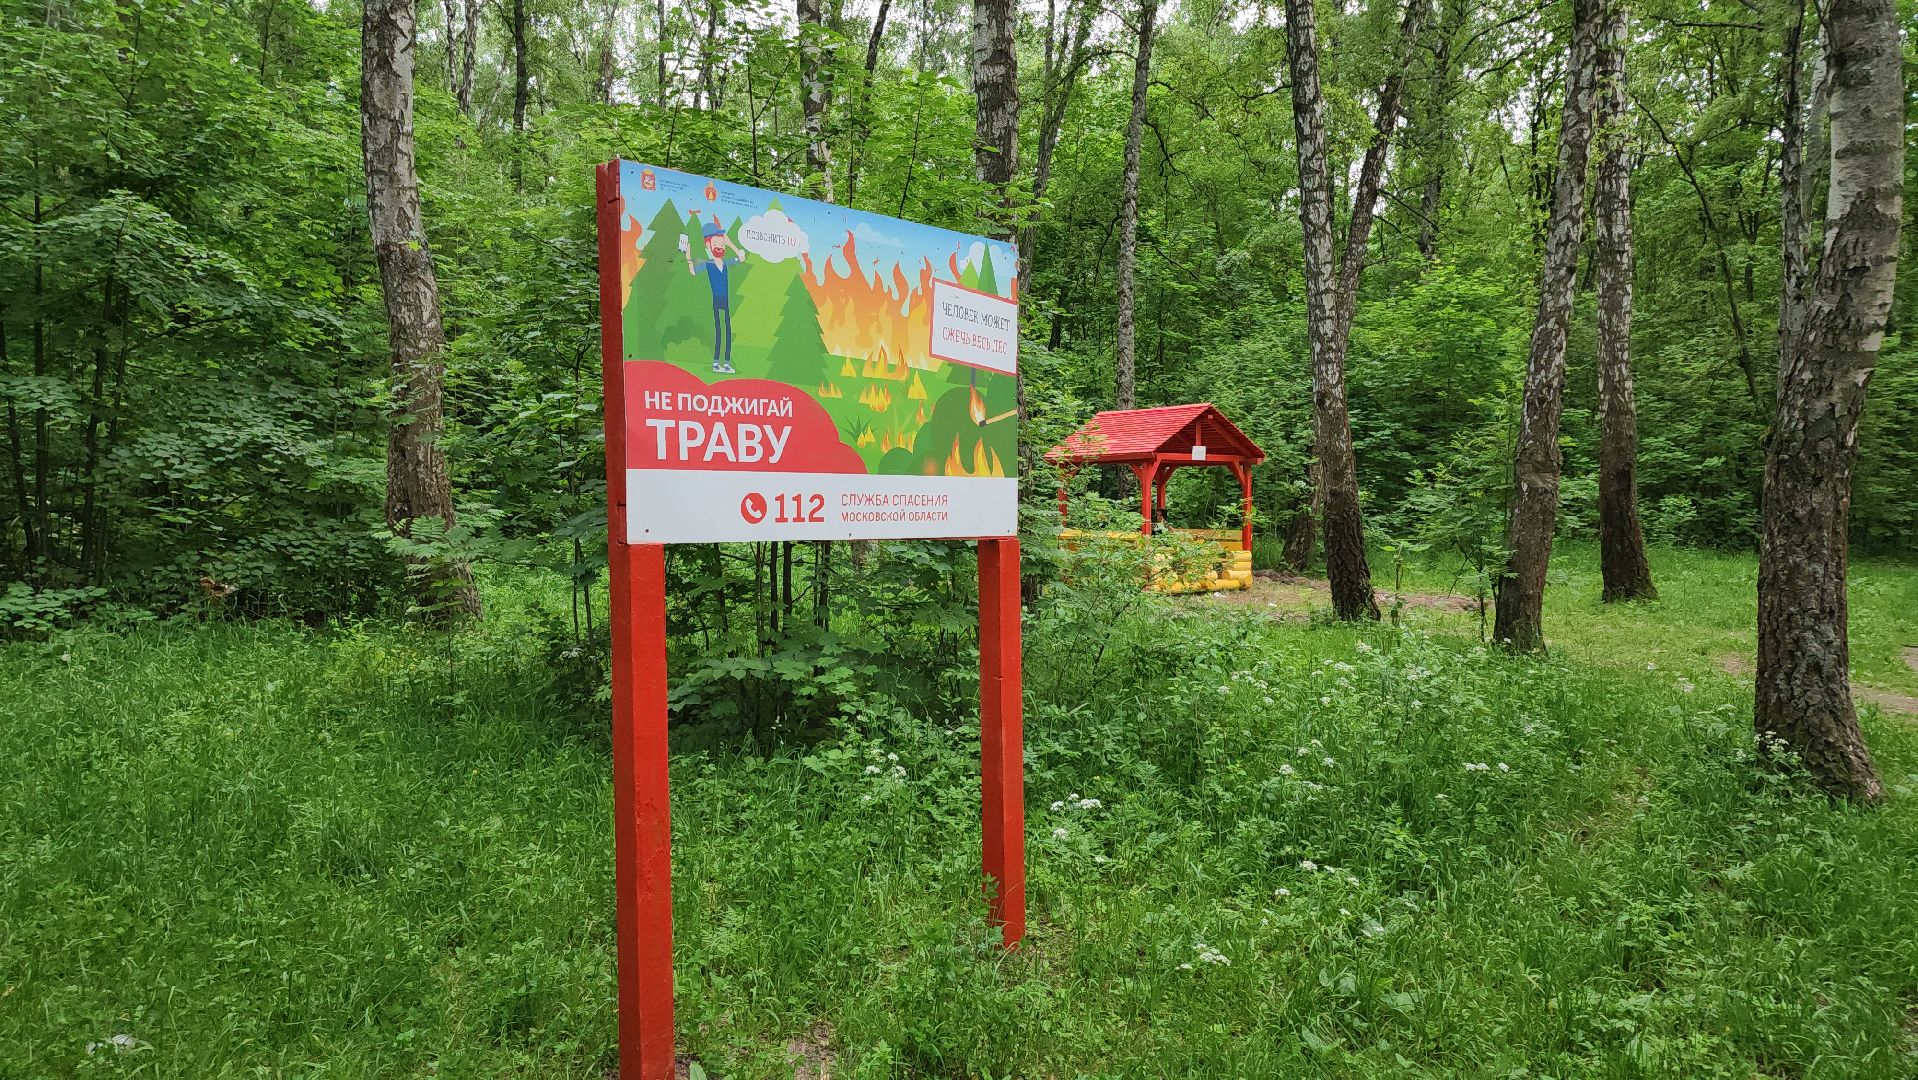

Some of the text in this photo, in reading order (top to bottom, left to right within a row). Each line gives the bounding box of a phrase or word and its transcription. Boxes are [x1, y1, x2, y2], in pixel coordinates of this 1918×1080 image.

[942, 301, 1011, 332] ЧЕЛОВЕК МОЖЕТ
[942, 326, 1008, 355] СЖЕЧЬ ВЕСЬ ЛЕС
[644, 390, 793, 418] НЕ ПОДЖИГАЙ
[645, 418, 793, 464] ТРАВУ
[774, 493, 825, 523] 112
[841, 493, 948, 507] СЛУЖБА СПАСЕНИЯ
[841, 508, 948, 522] МОСКОВСКОЙ ОБЛАСТИ
